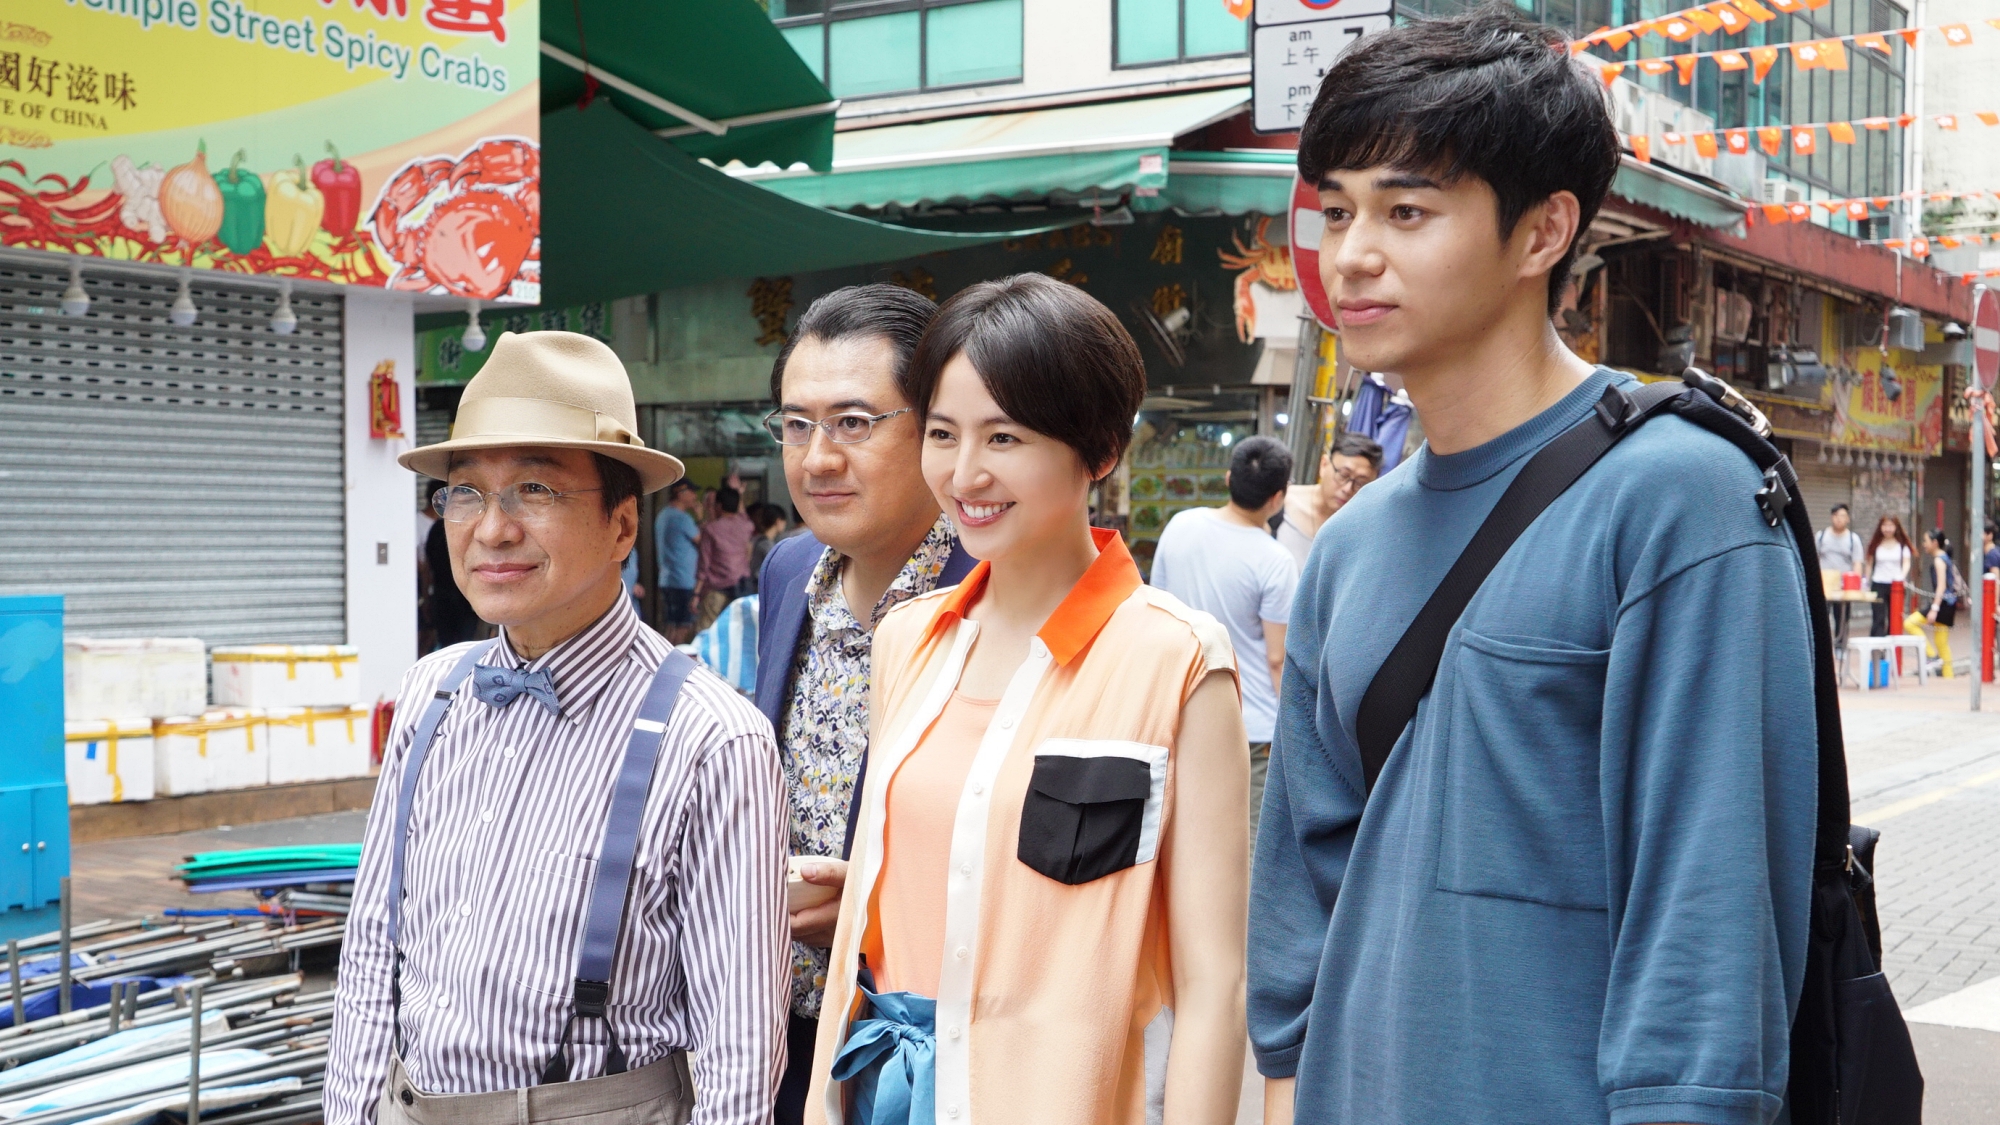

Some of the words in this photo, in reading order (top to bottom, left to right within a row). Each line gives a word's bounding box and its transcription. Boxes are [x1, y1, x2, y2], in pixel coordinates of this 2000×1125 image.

[209, 0, 315, 52] Street
[325, 24, 410, 79] Spicy
[421, 47, 506, 92] Crabs
[1289, 30, 1312, 42] am
[1282, 46, 1320, 66] 上午
[1288, 85, 1312, 100] pm
[20, 101, 45, 119] OF
[50, 107, 108, 130] CHINA
